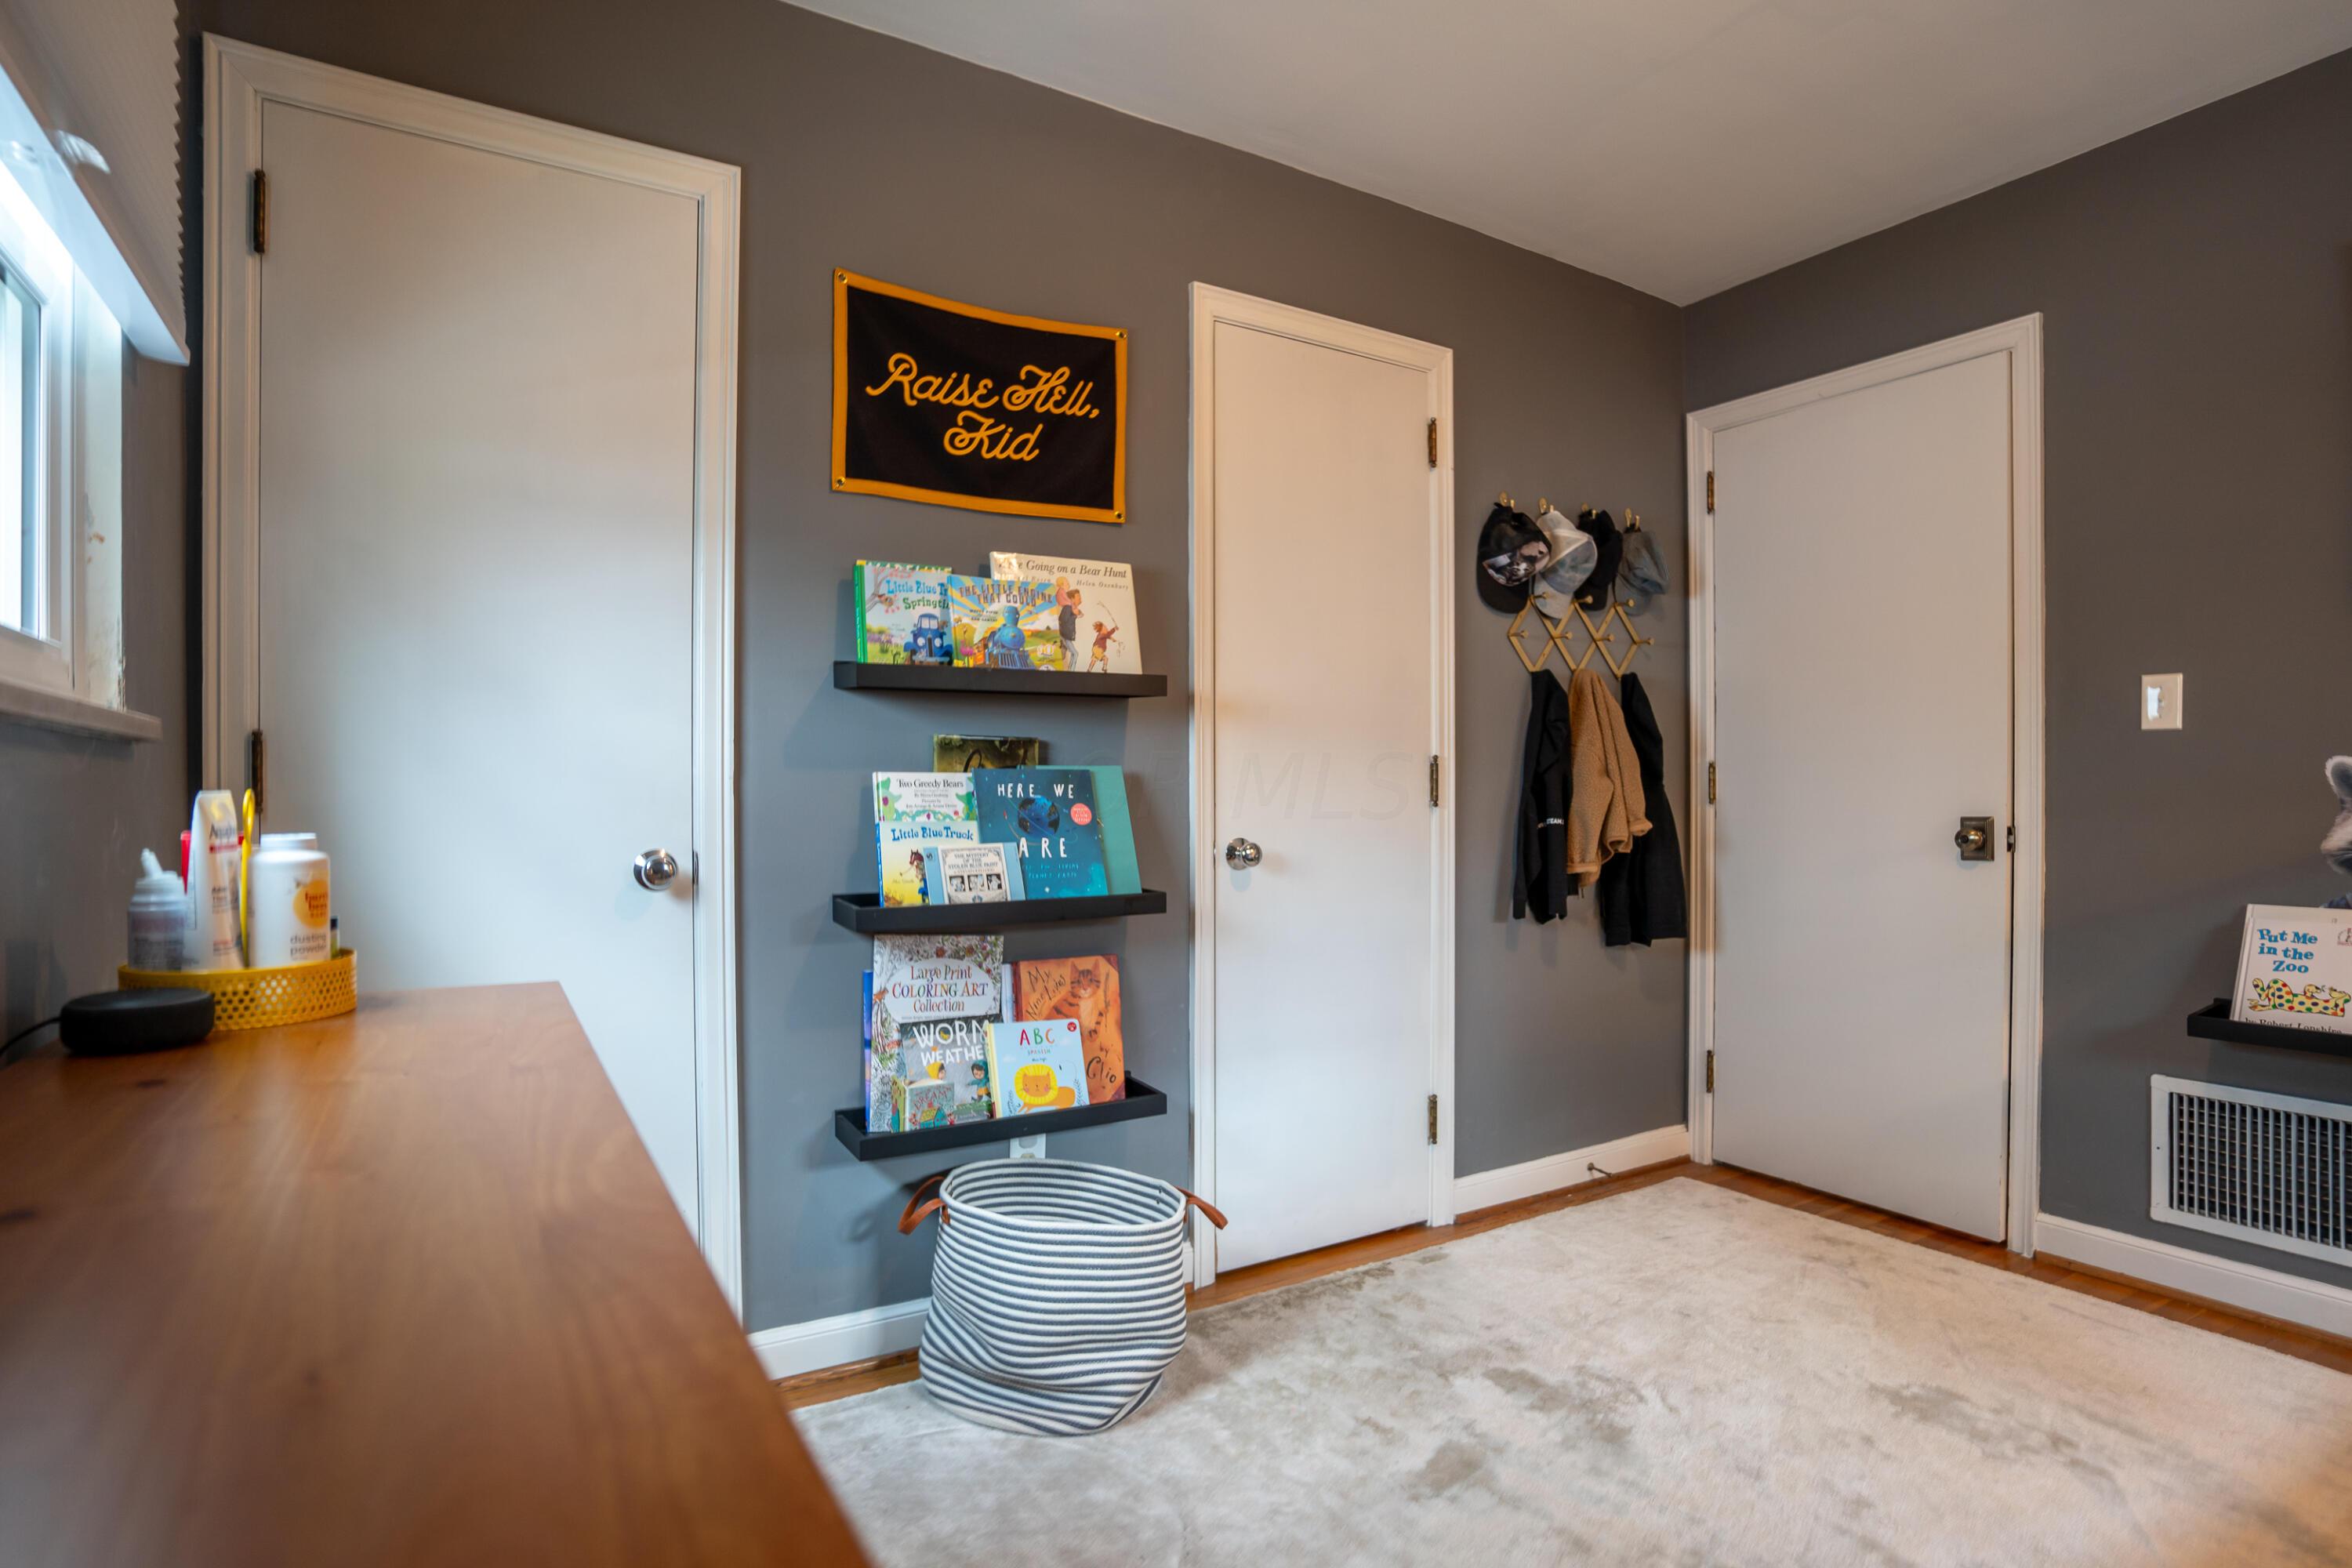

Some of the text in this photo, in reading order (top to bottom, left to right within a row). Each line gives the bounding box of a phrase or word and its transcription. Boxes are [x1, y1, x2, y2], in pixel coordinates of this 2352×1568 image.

[866, 352, 1099, 418] Raise Hell,
[943, 410, 1044, 461] Kid
[1026, 559, 1054, 575] Going
[1080, 564, 1102, 575] Bear
[1104, 566, 1127, 579] Hunt
[886, 579, 913, 594] Little
[916, 580, 937, 594] Blue
[959, 585, 977, 598] THE
[982, 583, 1013, 595] LITTLE
[1018, 586, 1053, 604] ENGINE
[902, 597, 949, 610] Springti
[977, 593, 1036, 607] THAT COULD
[897, 779, 964, 789] Two Greedy Bears
[997, 783, 1074, 799] HERE WE
[891, 826, 974, 841] Little Blue Truck
[1019, 837, 1067, 858] ARE
[2257, 928, 2318, 945] Put Me
[290, 942, 326, 956] powde
[2258, 943, 2314, 960] in the
[911, 964, 972, 982] Large Print
[2273, 960, 2310, 974] Zoo
[1028, 967, 1051, 993] My
[892, 981, 989, 999] COLORING ART
[913, 997, 965, 1013] Collection
[920, 1045, 985, 1066] WEATHE
[1087, 1056, 1116, 1083] Clio
